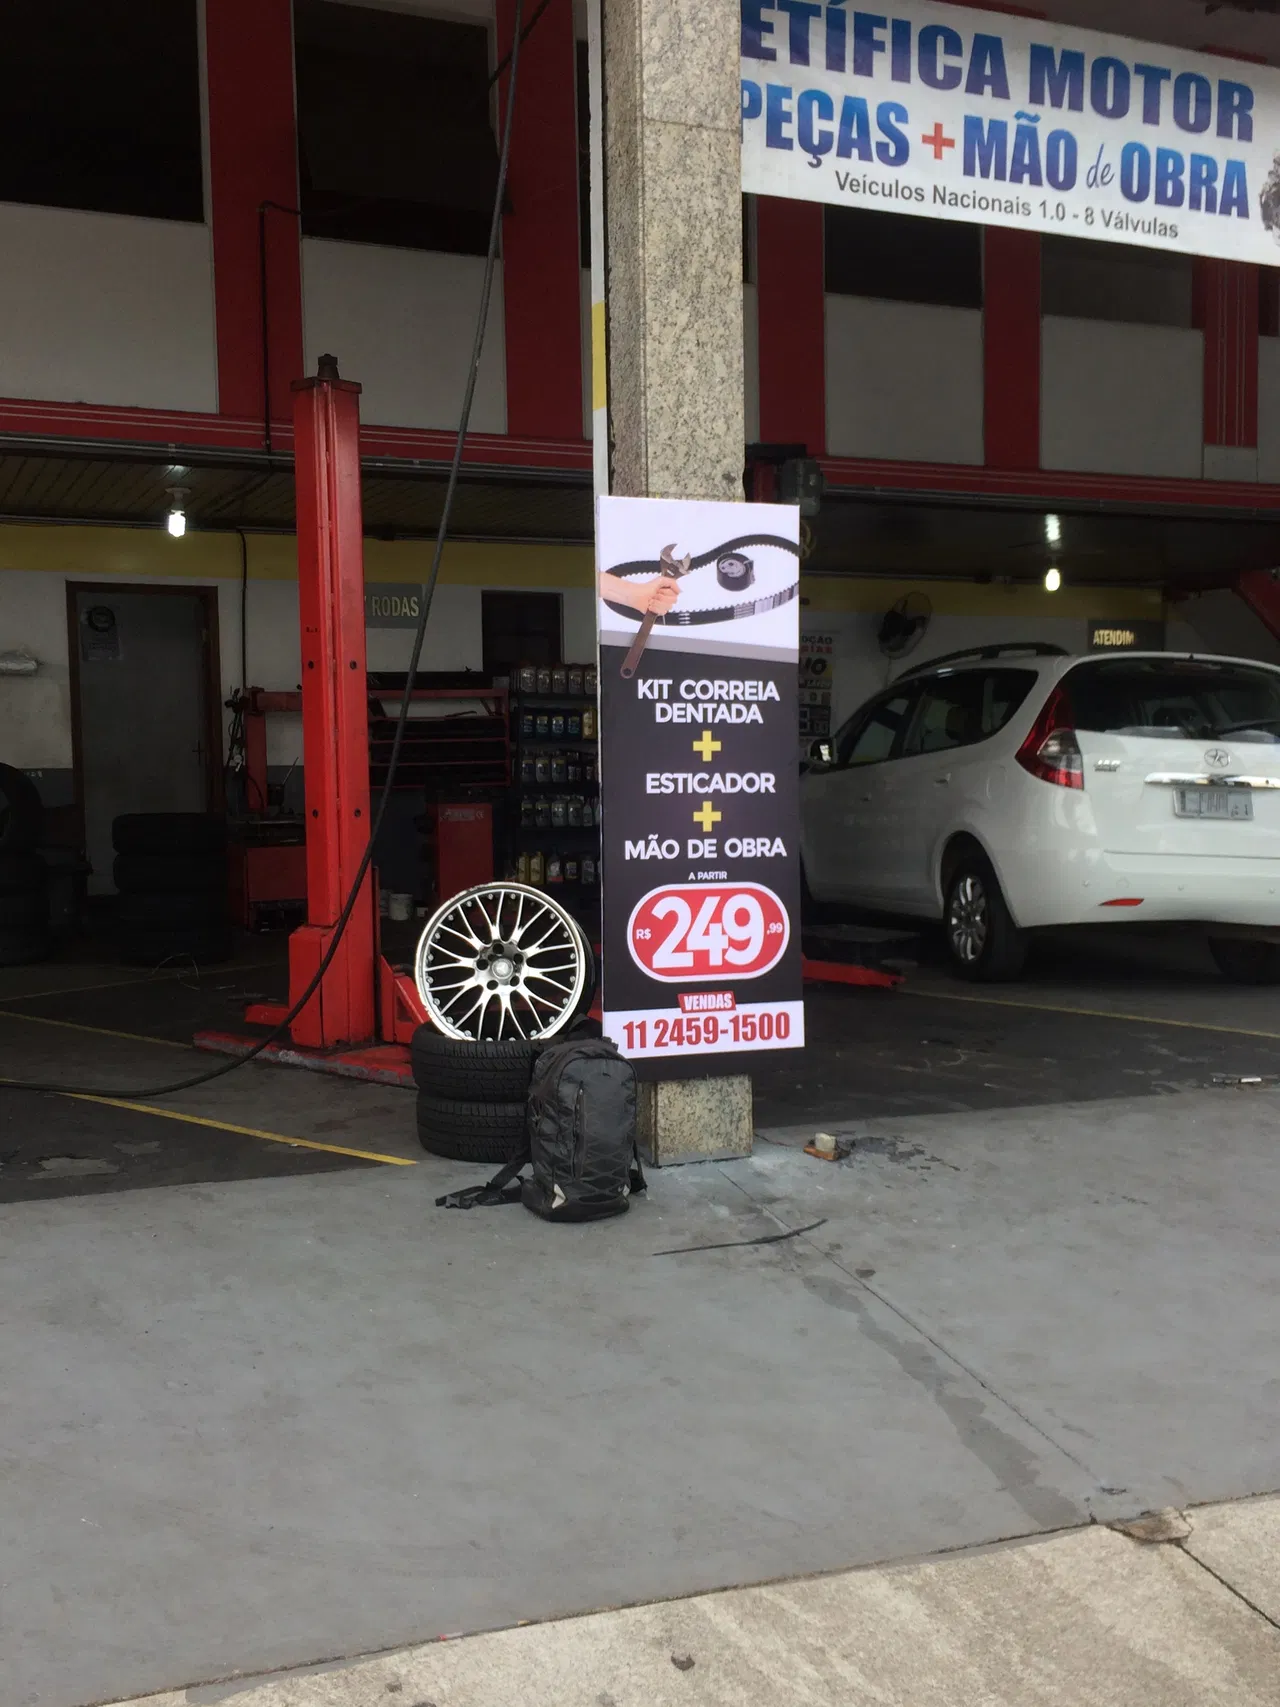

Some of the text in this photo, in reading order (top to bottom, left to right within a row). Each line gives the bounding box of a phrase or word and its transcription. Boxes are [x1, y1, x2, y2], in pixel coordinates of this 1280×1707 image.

[1028, 42, 1255, 143] MOTOR
[741, 79, 910, 168] PEÇAS
[962, 111, 1078, 192] MÃO
[1086, 143, 1115, 190] de
[1120, 141, 1250, 220] OBRA
[835, 170, 925, 203] Veículos
[932, 184, 1032, 217] Nacionais
[1100, 208, 1179, 239] Válvulas
[372, 596, 420, 617] RODAS
[637, 679, 780, 701] KIT CORREIA
[655, 703, 764, 724] DENTADA
[646, 773, 776, 794] ESTICADOR
[624, 834, 788, 860] MÃO DE OBRA
[688, 871, 728, 880] A PARTIR
[636, 928, 651, 940] R$
[651, 894, 765, 969] 249
[684, 993, 733, 1011] VENDAS
[623, 1012, 790, 1049] 11 2459-1500
